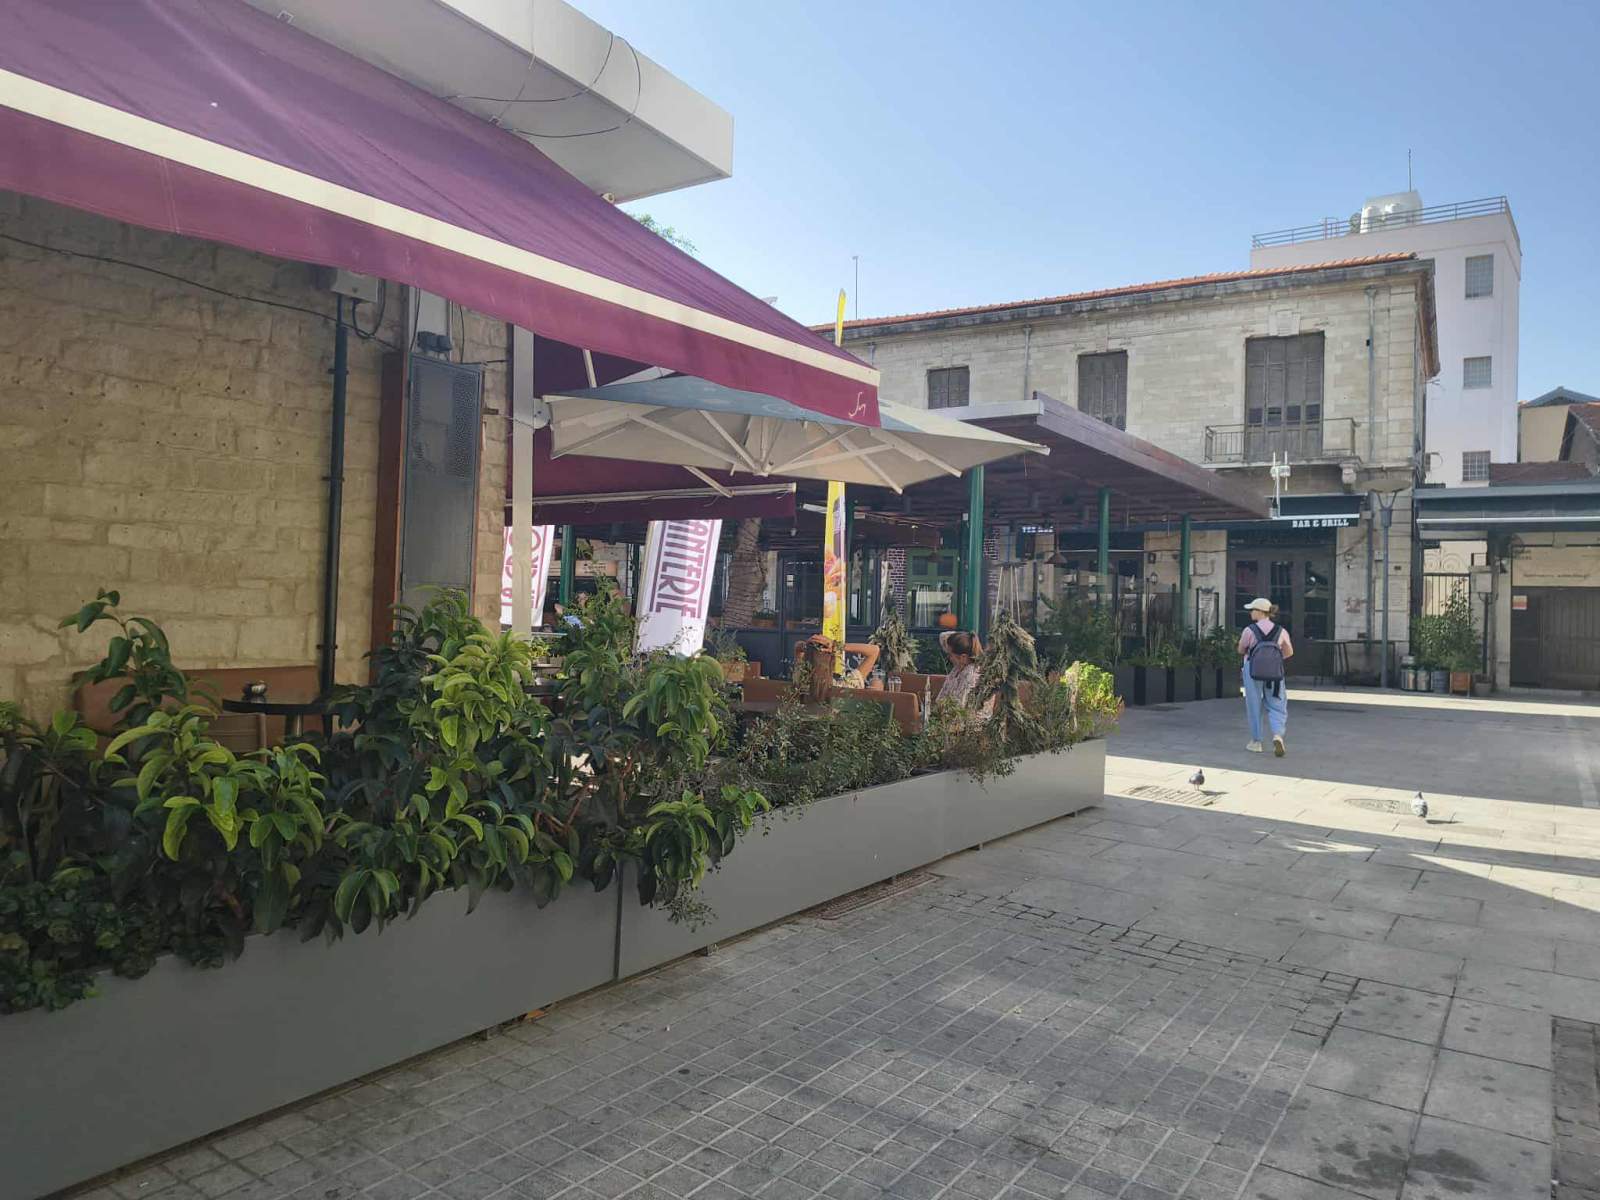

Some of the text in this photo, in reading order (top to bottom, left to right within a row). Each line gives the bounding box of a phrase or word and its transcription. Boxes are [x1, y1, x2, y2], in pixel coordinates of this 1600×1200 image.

[1292, 519, 1349, 528] BAR & GRILL
[656, 520, 709, 618] ANTERIE
